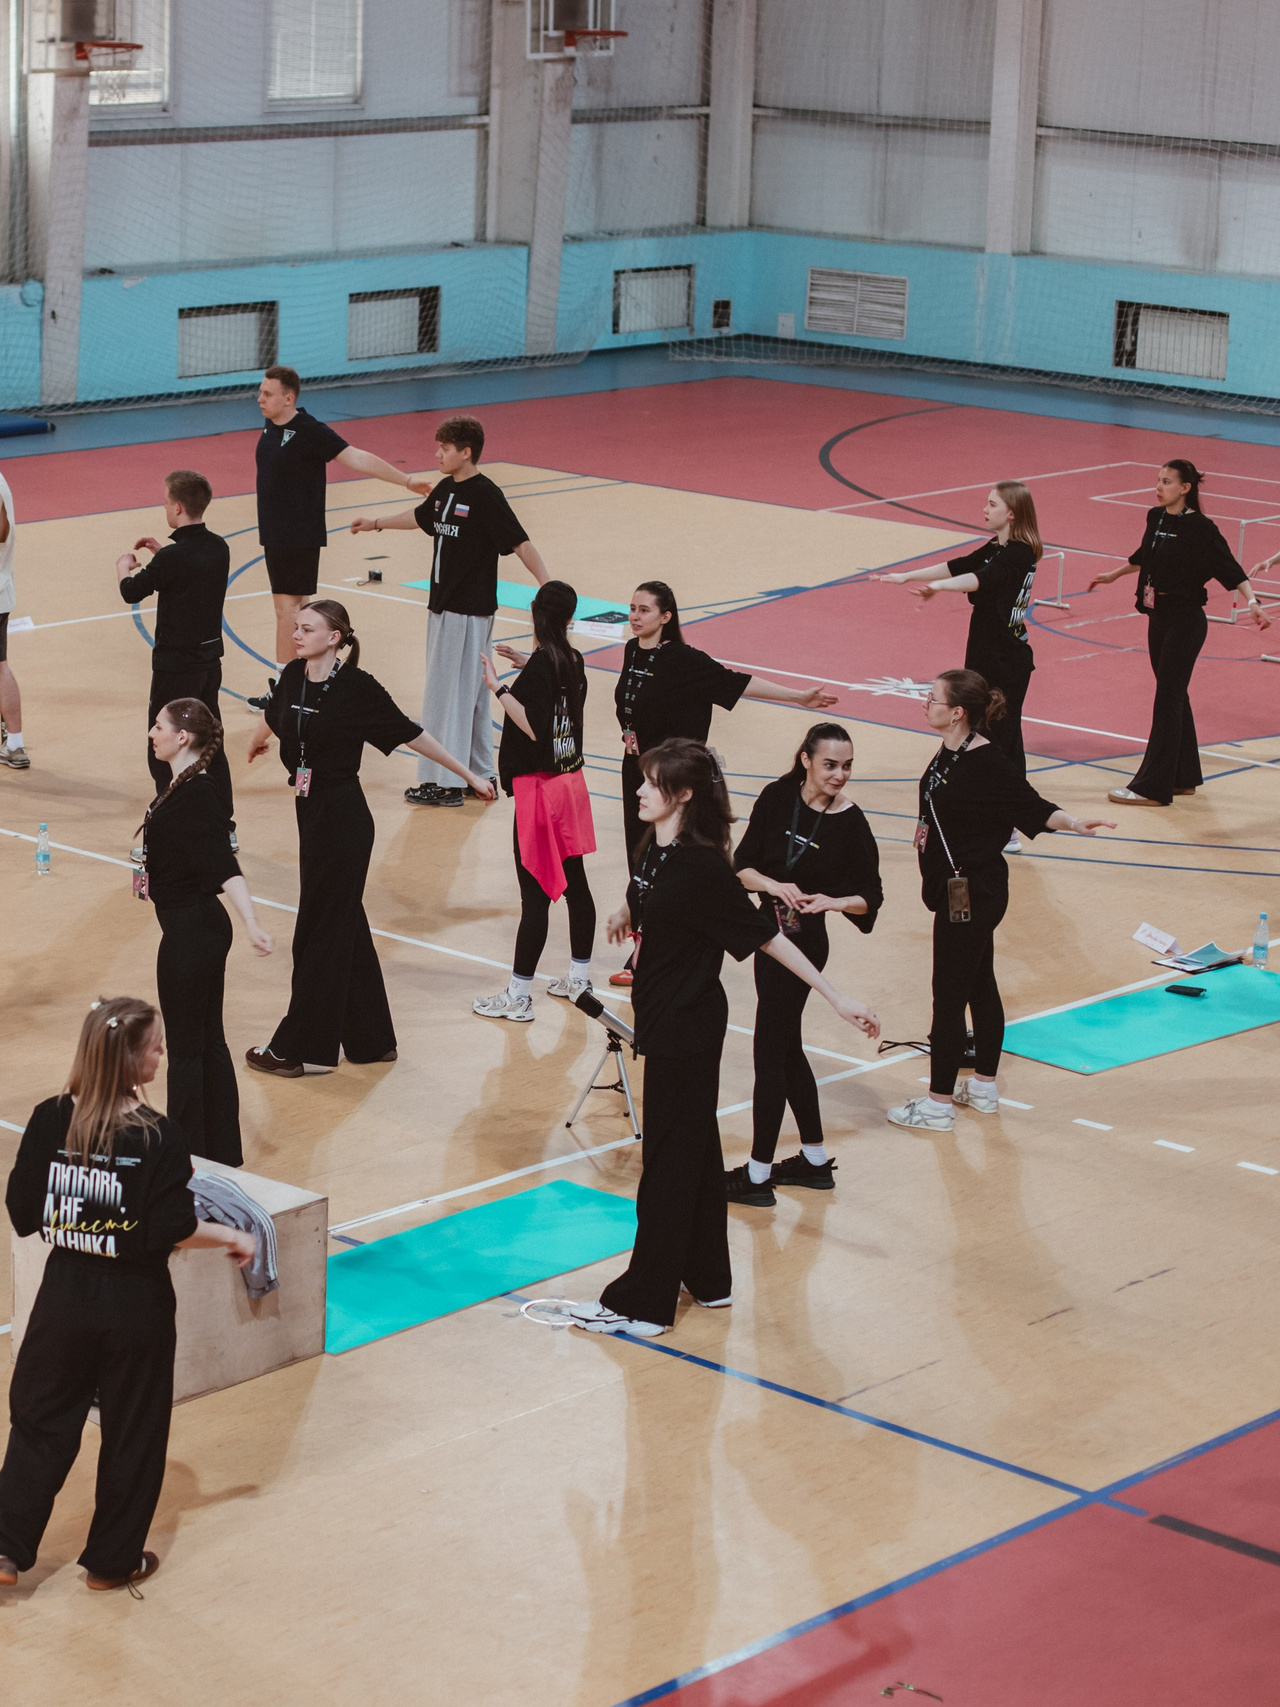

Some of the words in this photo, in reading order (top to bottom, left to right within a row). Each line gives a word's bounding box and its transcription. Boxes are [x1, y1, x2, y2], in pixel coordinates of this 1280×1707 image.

[43, 1192, 55, 1227] А
[59, 1195, 84, 1227] НЕ
[49, 1209, 138, 1236] вместе
[42, 1226, 117, 1258] ПАНИКА
